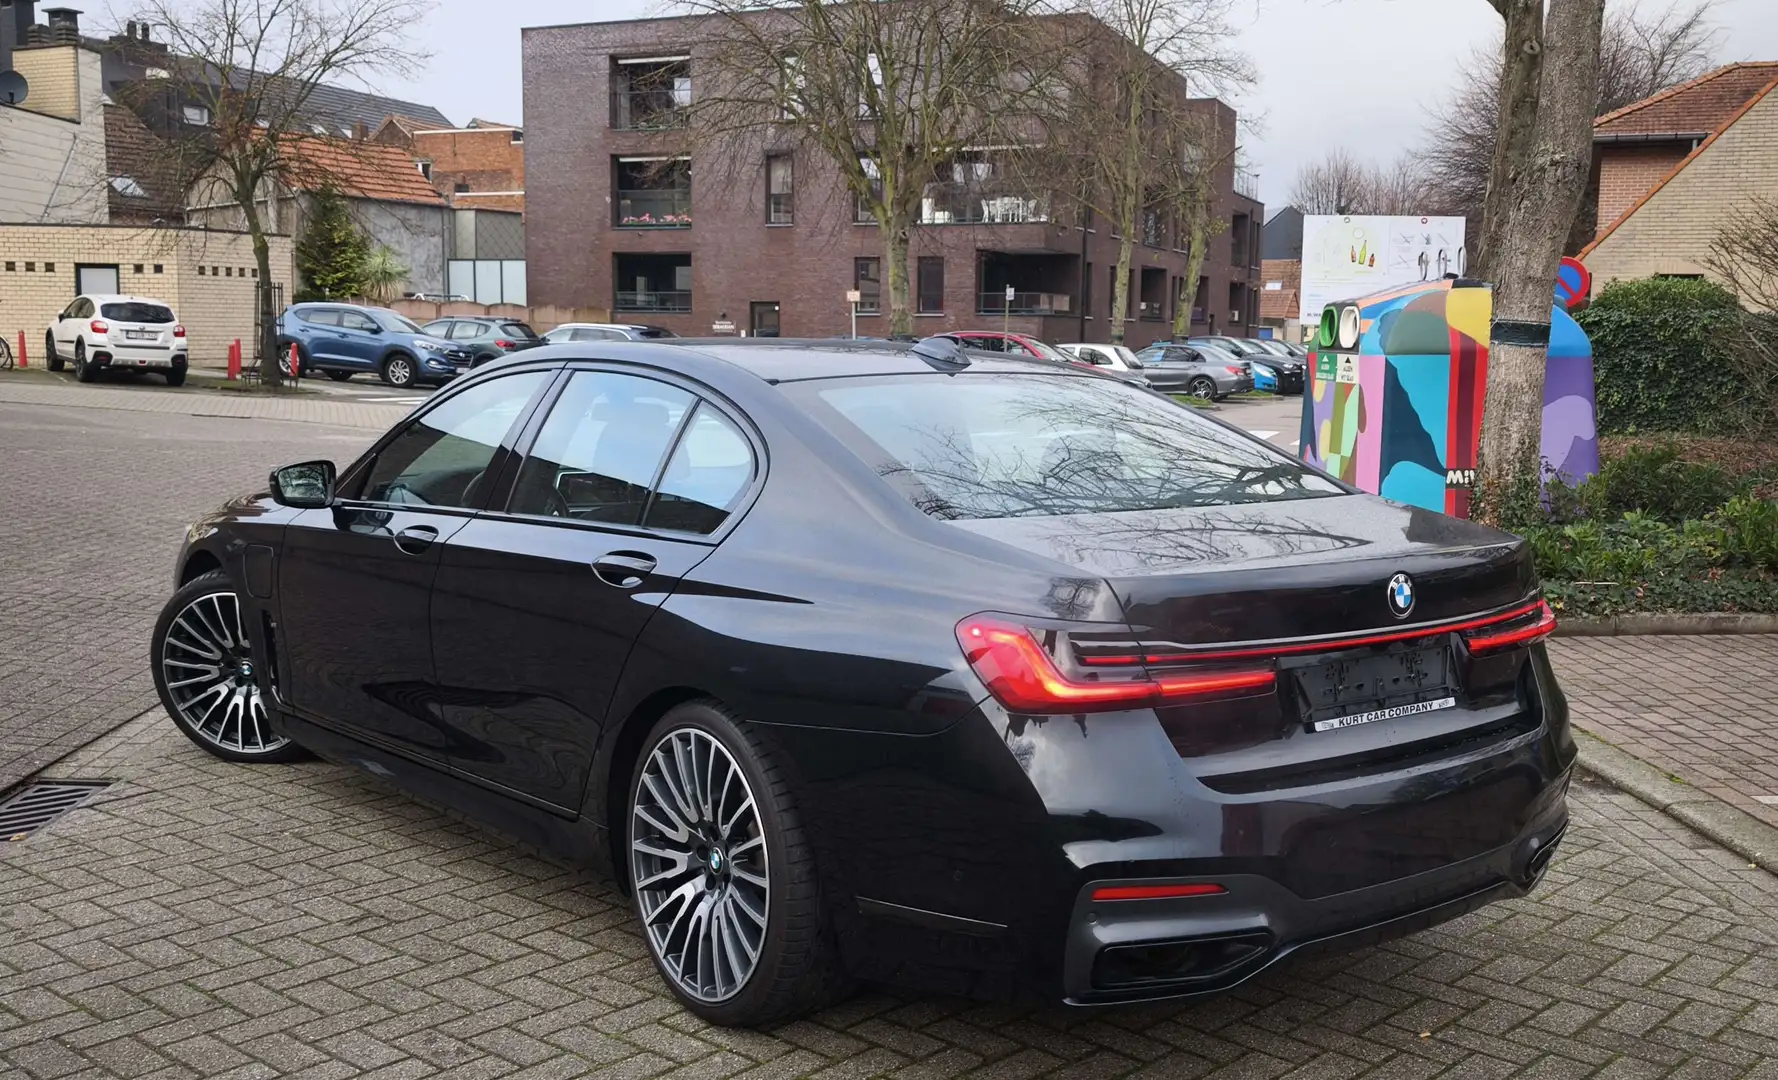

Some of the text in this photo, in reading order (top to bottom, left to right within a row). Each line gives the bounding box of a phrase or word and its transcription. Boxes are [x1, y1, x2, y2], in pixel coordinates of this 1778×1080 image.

[1338, 714, 1365, 727] KURT
[1366, 710, 1386, 722] CAR
[1388, 702, 1434, 718] COMPANY
